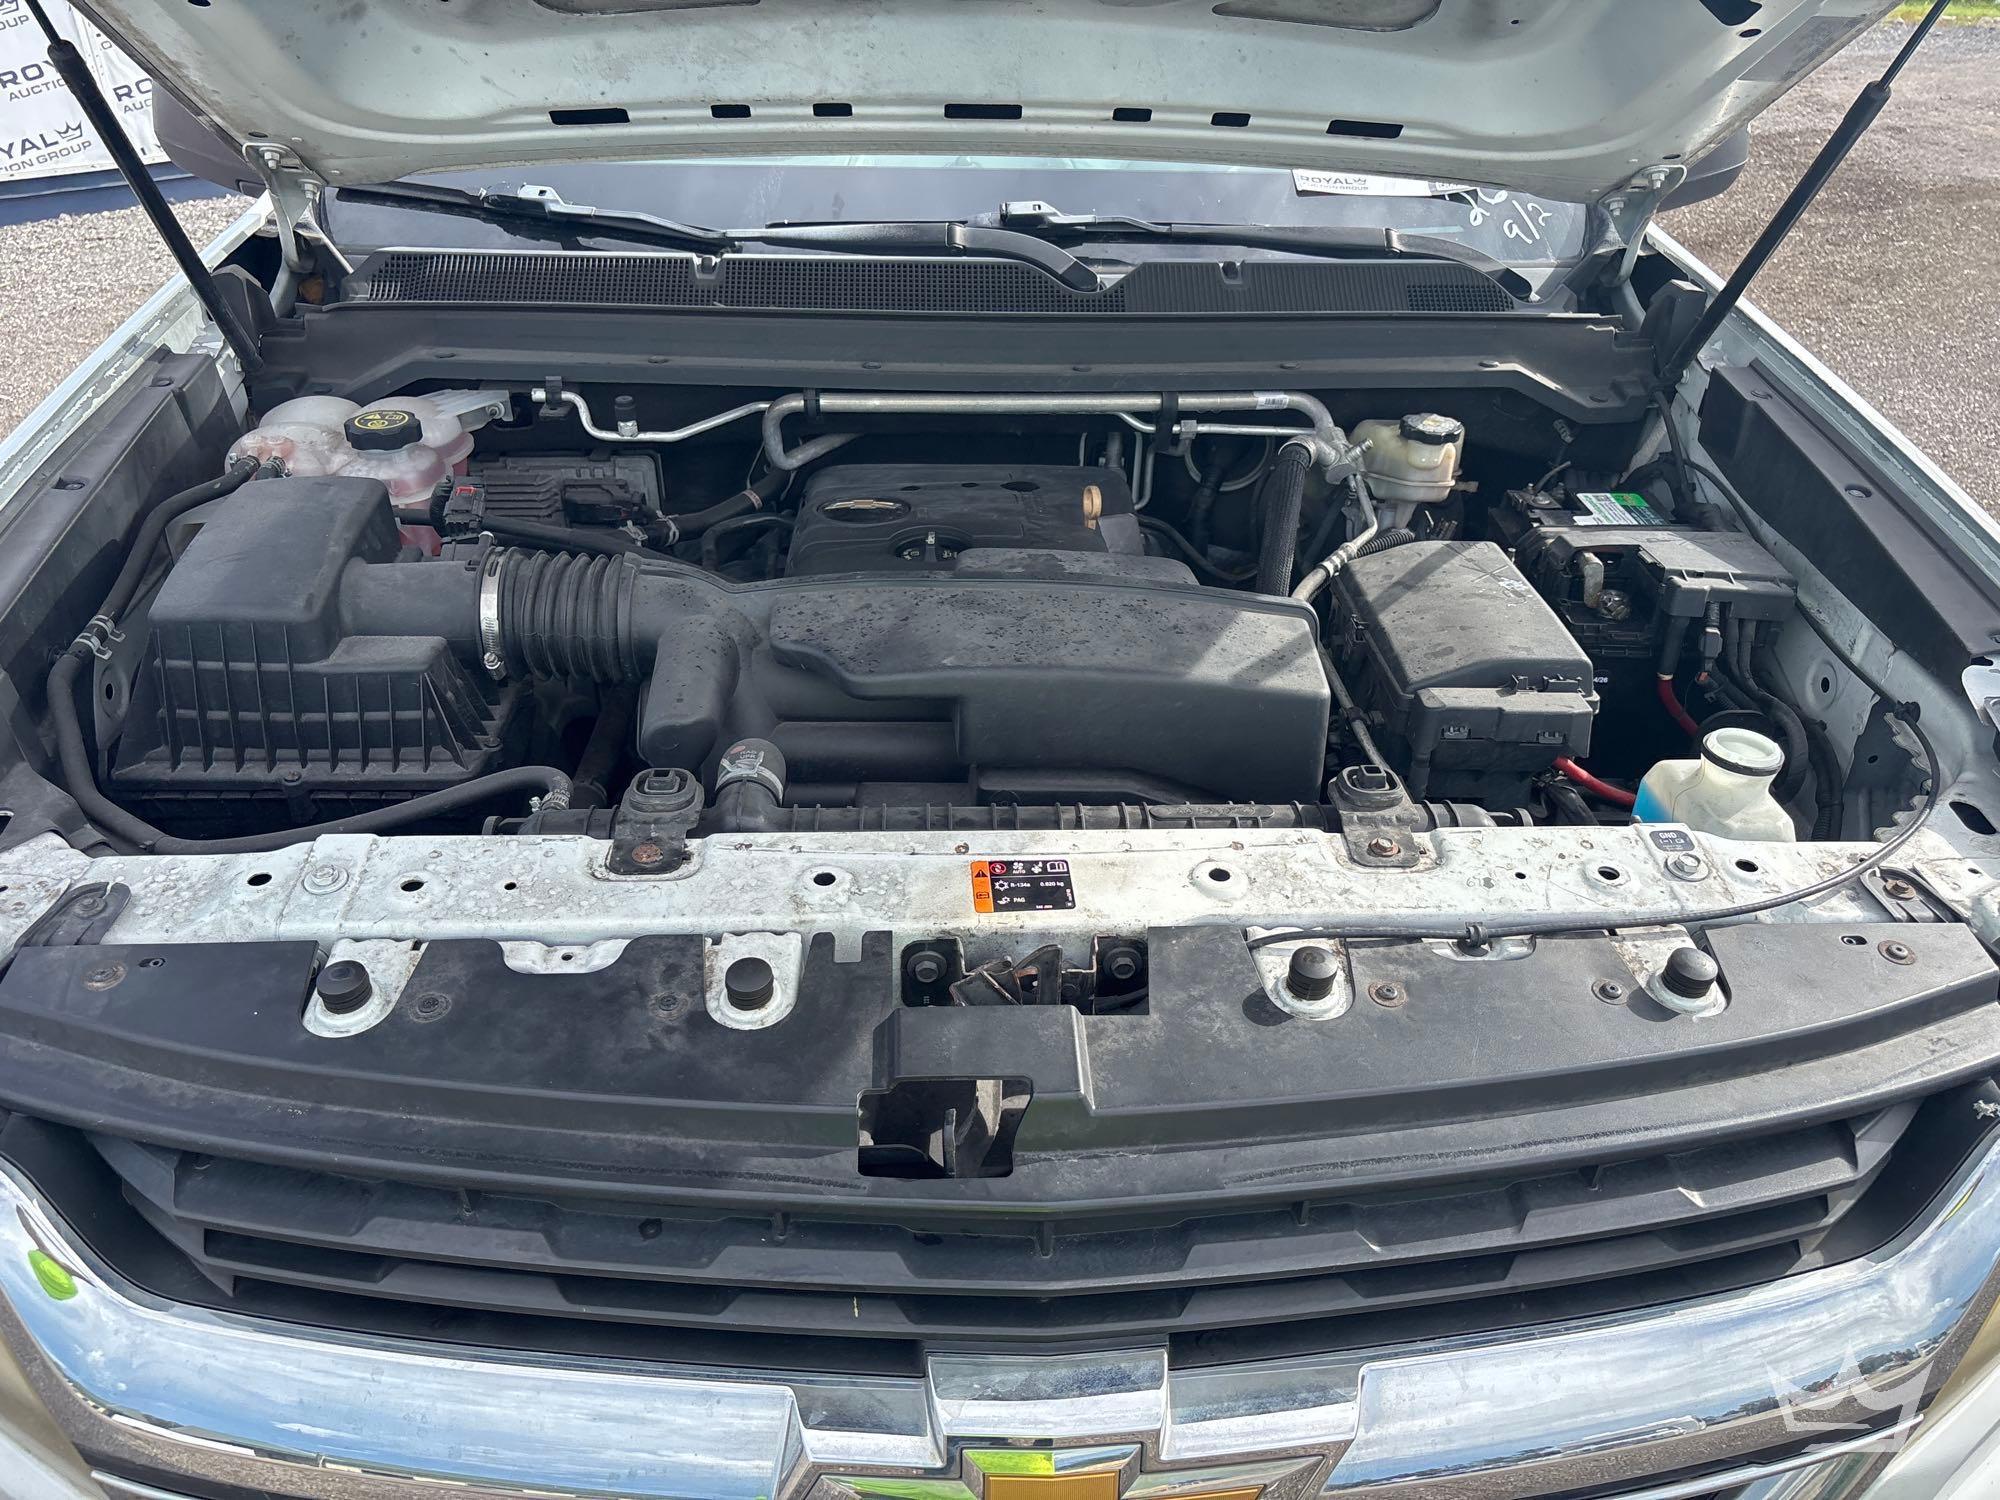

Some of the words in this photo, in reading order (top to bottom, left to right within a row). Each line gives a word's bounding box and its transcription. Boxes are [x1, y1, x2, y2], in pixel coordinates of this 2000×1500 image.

[37, 140, 92, 164] GROUP
[1300, 175, 1353, 185] ROYAL
[1503, 200, 1553, 245] 9/2
[1658, 831, 1677, 839] GND
